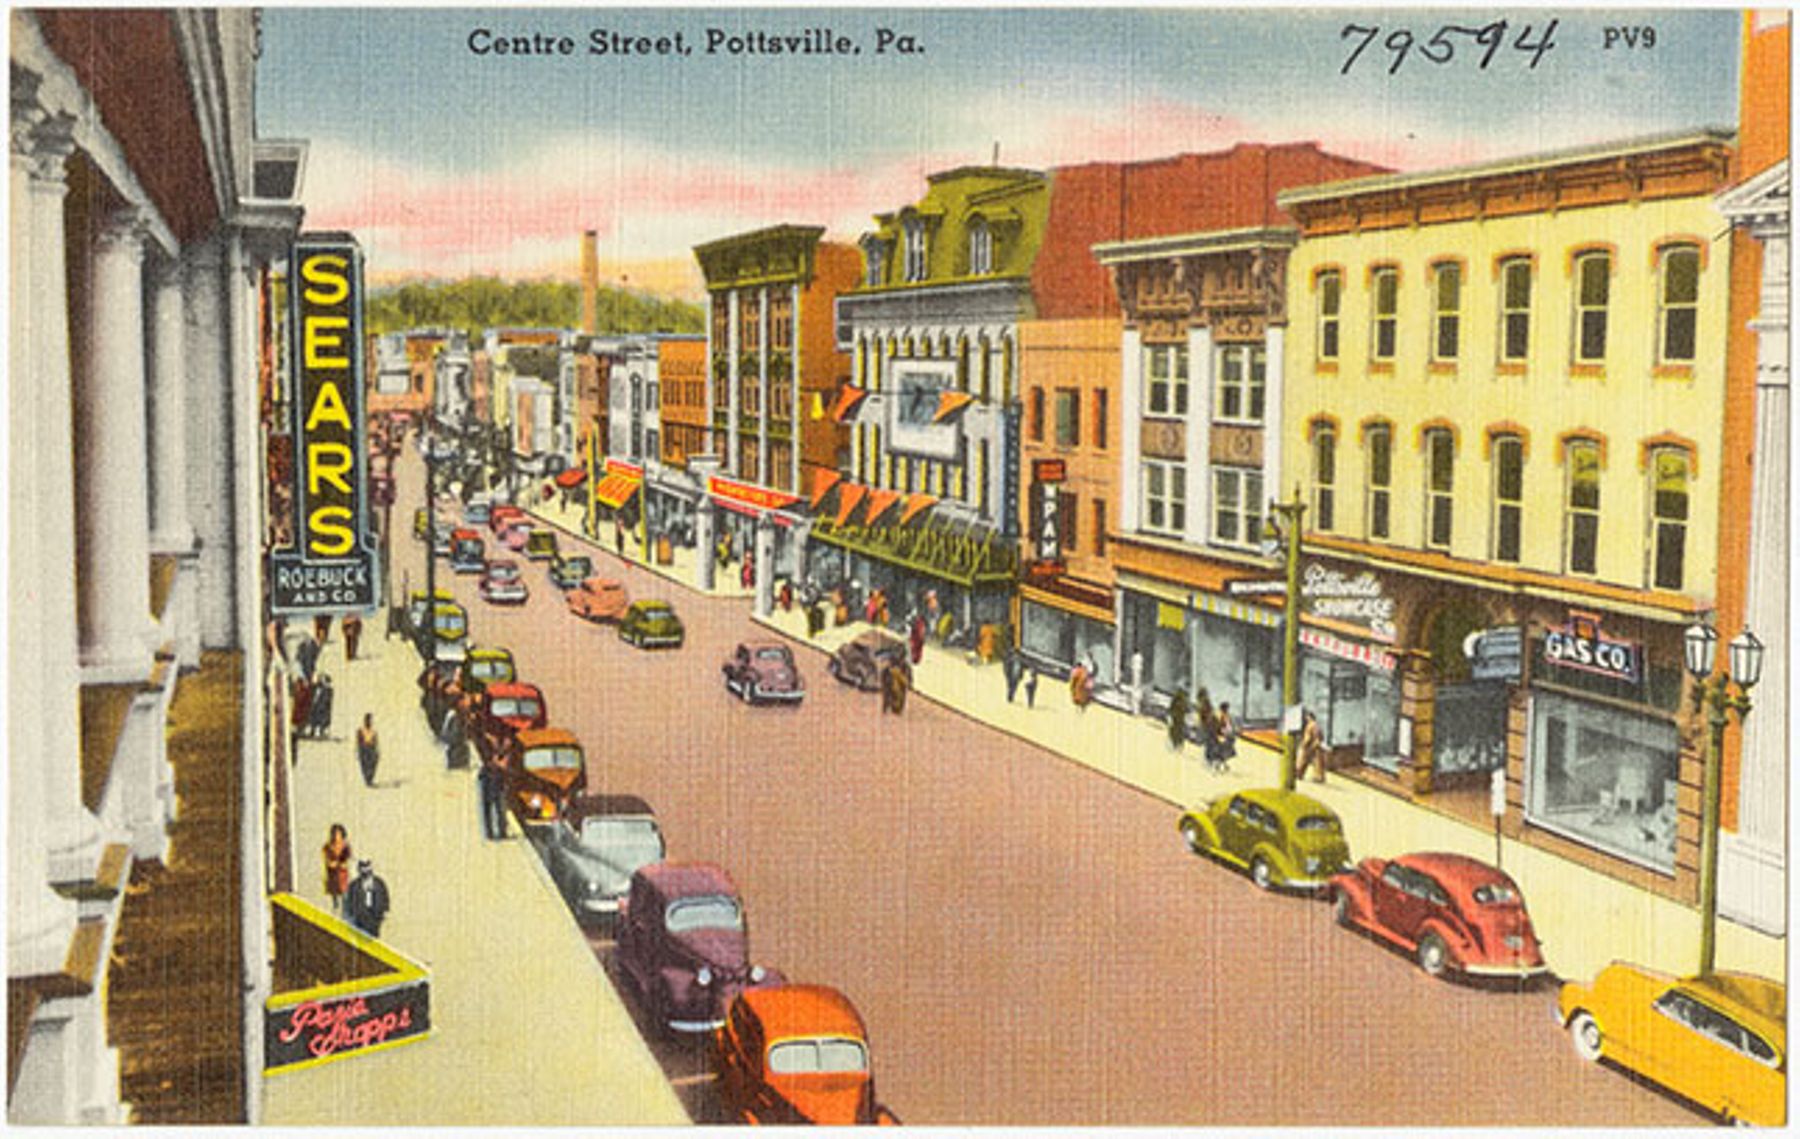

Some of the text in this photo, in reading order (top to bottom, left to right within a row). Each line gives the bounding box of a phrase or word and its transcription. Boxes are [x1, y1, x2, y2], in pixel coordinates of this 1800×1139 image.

[1341, 19, 1559, 75] 79594
[301, 254, 355, 556] SEARS
[278, 565, 368, 589] ROEBUCK
[293, 591, 328, 604] AND
[1545, 630, 1632, 674] GAS CO.
